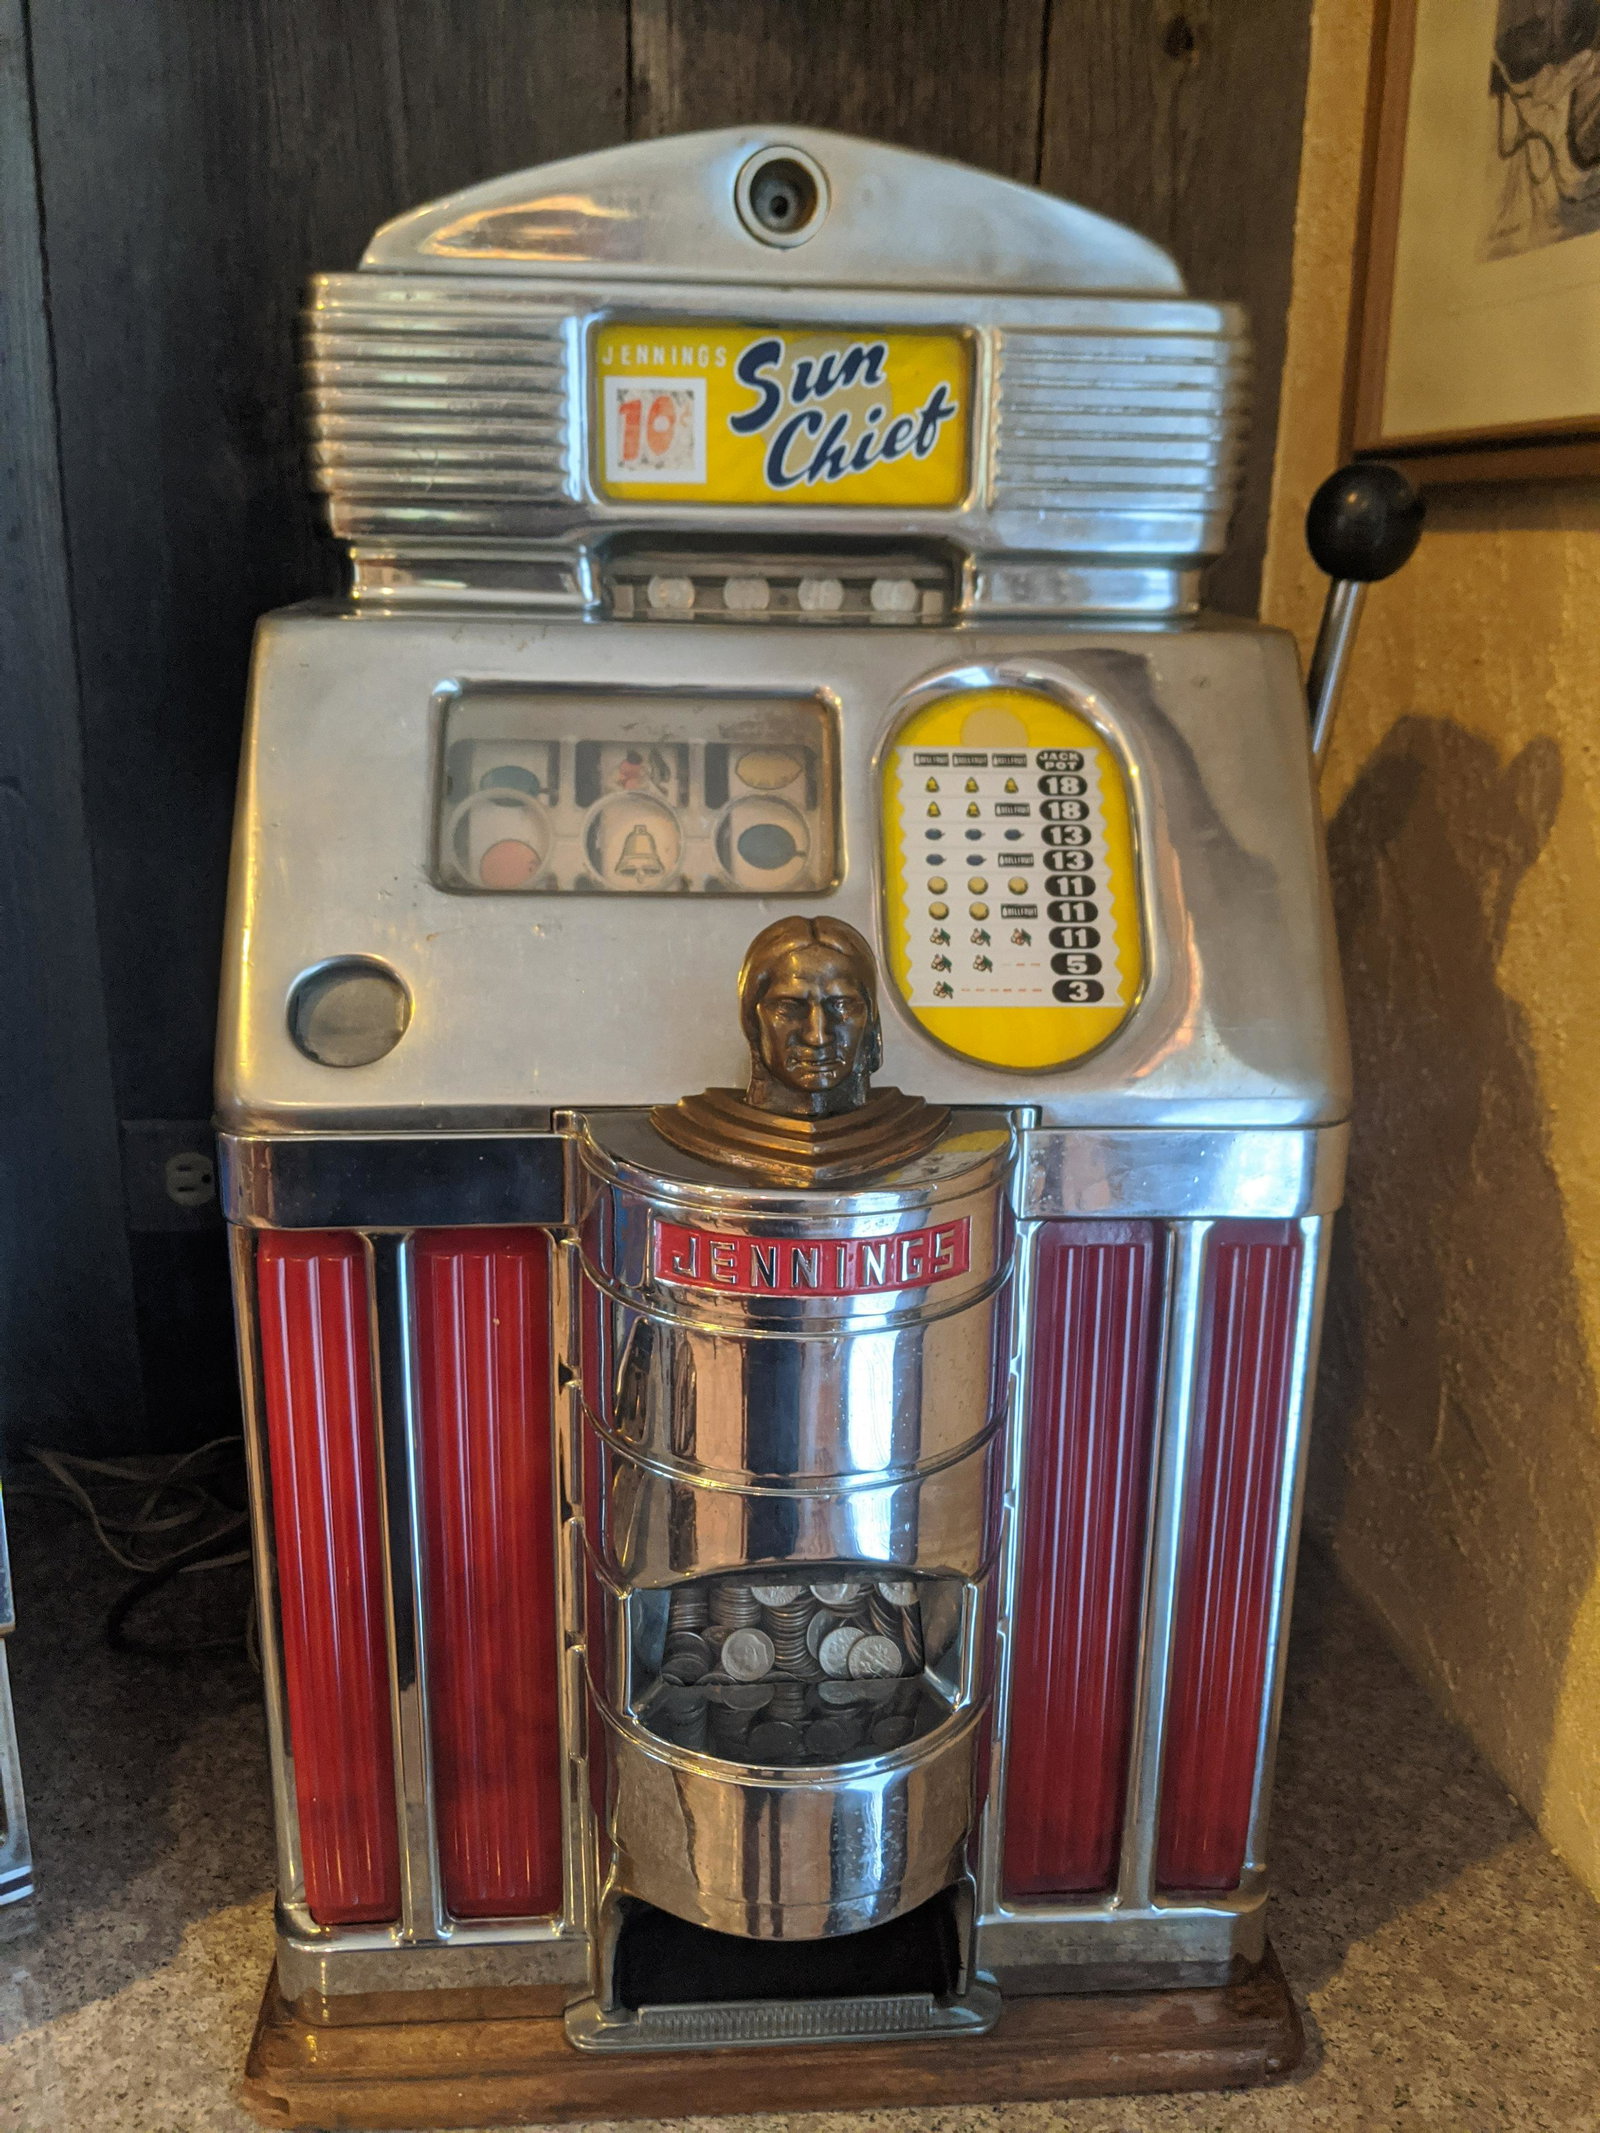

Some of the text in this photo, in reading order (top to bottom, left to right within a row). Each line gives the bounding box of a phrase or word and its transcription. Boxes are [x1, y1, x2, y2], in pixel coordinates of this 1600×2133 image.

[603, 345, 727, 368] JENNINGS
[731, 339, 886, 433] Sun
[764, 382, 958, 489] Chief
[1039, 751, 1080, 761] JACK
[1044, 761, 1077, 770] POT
[1046, 776, 1080, 795] 18
[1048, 801, 1082, 820] 18
[1050, 825, 1083, 845] 13
[1052, 851, 1085, 870] 13
[1057, 876, 1083, 896] 11
[1059, 902, 1085, 921] 11
[1061, 928, 1087, 948] 11
[1066, 954, 1088, 975] 5
[1068, 981, 1089, 1002] 3
[672, 1230, 955, 1289] JENNINGS
